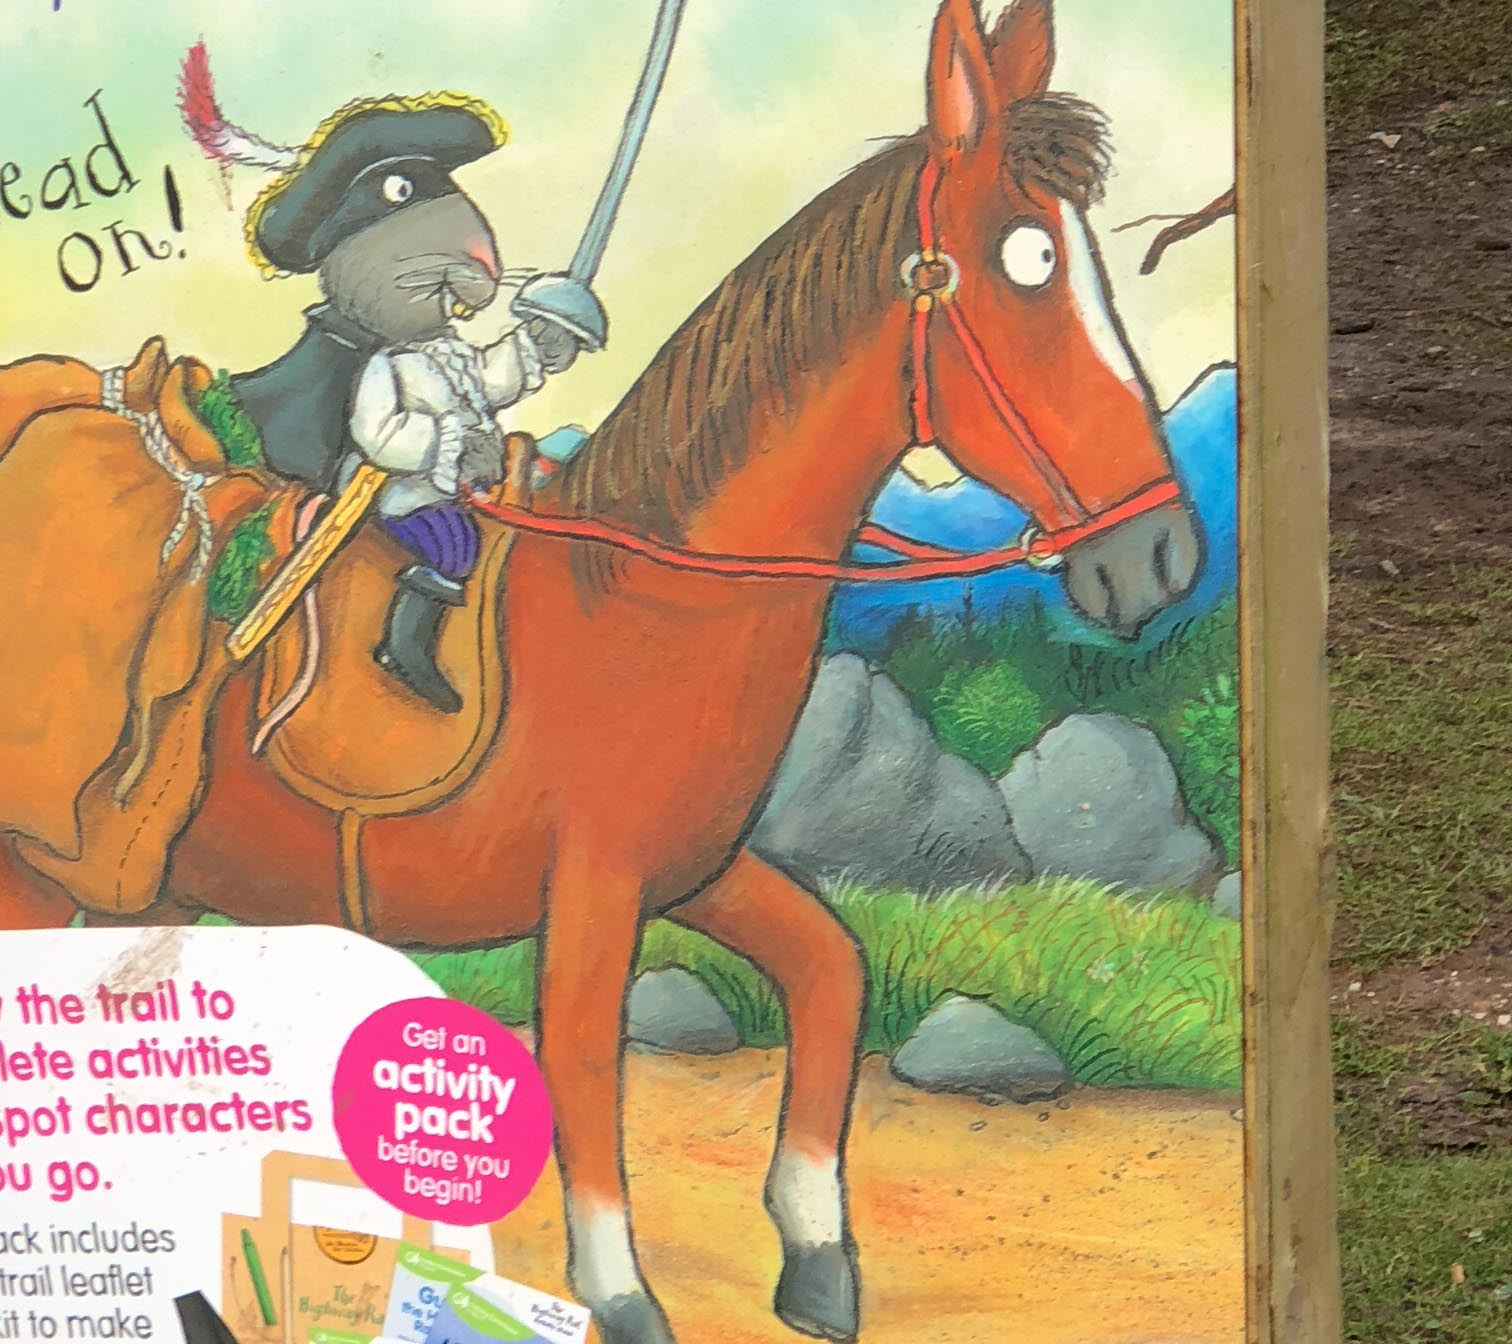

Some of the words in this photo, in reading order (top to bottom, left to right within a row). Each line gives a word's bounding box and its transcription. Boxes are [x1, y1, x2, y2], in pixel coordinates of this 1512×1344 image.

[57, 163, 190, 294] on!
[19, 987, 87, 1027] the
[96, 979, 180, 1023] trail
[192, 984, 235, 1021] to
[88, 1038, 272, 1082] activities
[401, 1020, 447, 1053] Get
[453, 1028, 486, 1057] an
[372, 1055, 516, 1115] activity
[87, 1092, 313, 1137] characters
[393, 1100, 496, 1145] pack
[377, 1136, 459, 1171] before
[462, 1153, 510, 1181] you
[47, 1159, 113, 1202] go.
[403, 1168, 483, 1205] begin!
[49, 1221, 177, 1255] includes
[61, 1264, 154, 1297] leaflet
[28, 1310, 58, 1339] to
[66, 1308, 154, 1340] make
[363, 1305, 386, 1325] Ra
